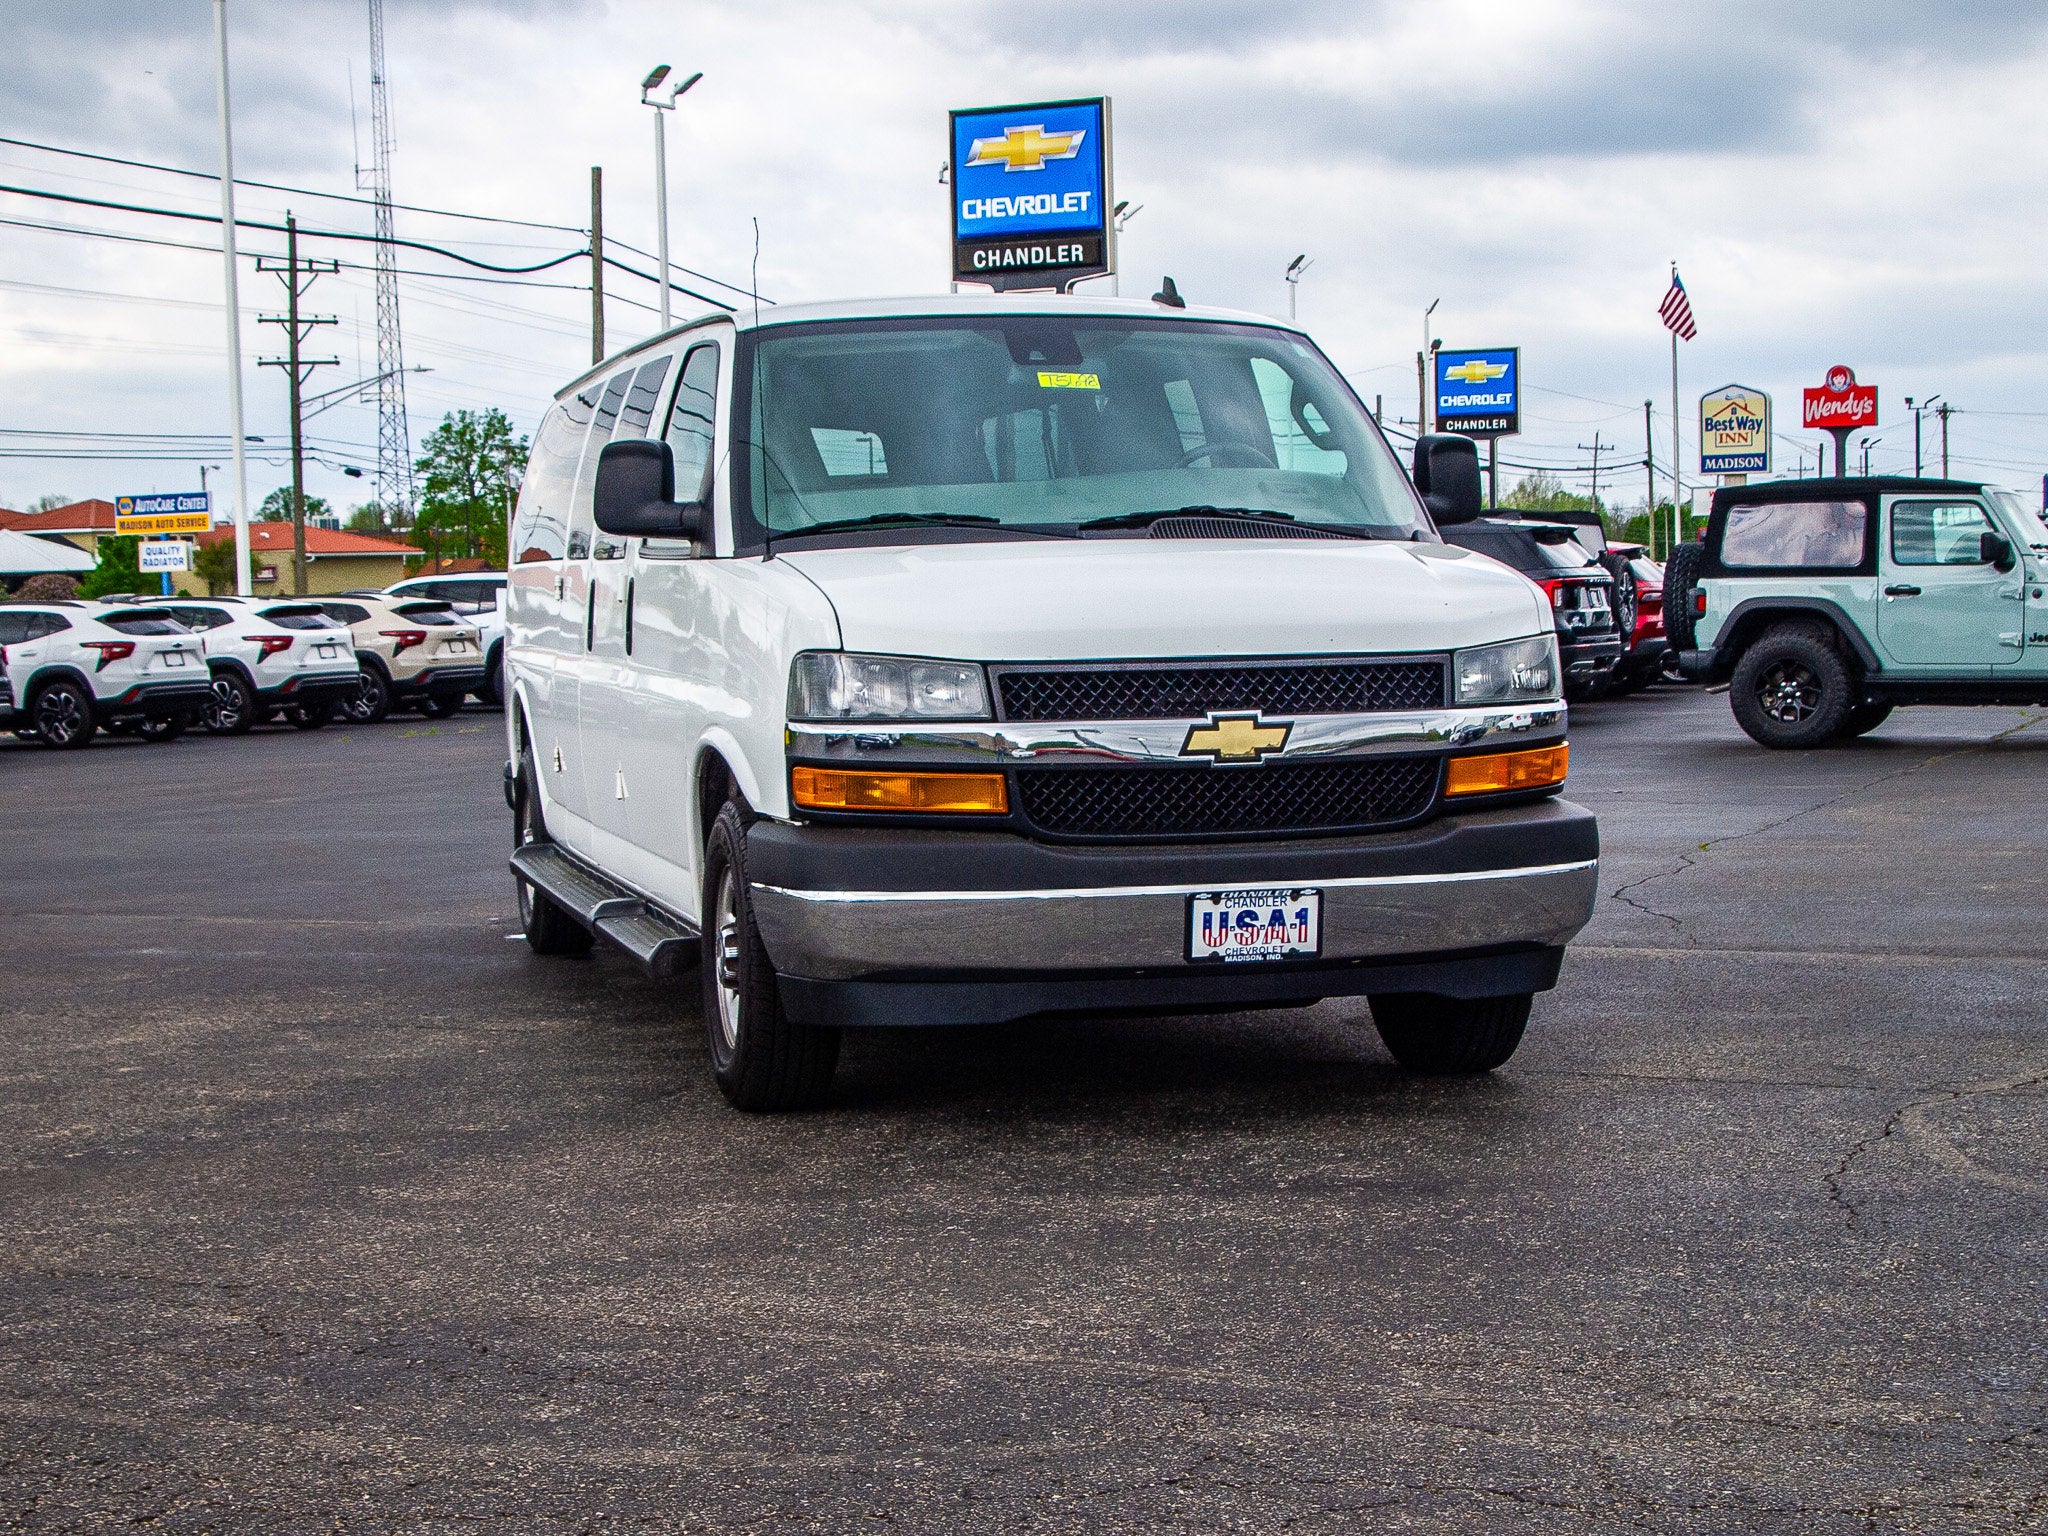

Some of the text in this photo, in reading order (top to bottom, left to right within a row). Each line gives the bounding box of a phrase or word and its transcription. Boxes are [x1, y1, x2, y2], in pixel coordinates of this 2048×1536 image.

[962, 191, 1092, 220] CHEVROLET
[973, 244, 1084, 269] CHANDLER
[1440, 393, 1513, 407] CHEVROLET
[1805, 392, 1873, 423] Wendy's
[1446, 419, 1507, 431] CHANDLER
[1705, 415, 1764, 435] Best Way
[1718, 432, 1749, 444] INN
[1705, 456, 1764, 469] MADISON
[119, 517, 207, 530] MADISON AUTO SERVICE
[145, 545, 181, 556] QUALITY
[142, 557, 184, 567] RADIATOR
[1221, 890, 1292, 898] CHANDLER
[1224, 896, 1288, 909] CHANDLER
[1224, 946, 1284, 956] CHEVROLET
